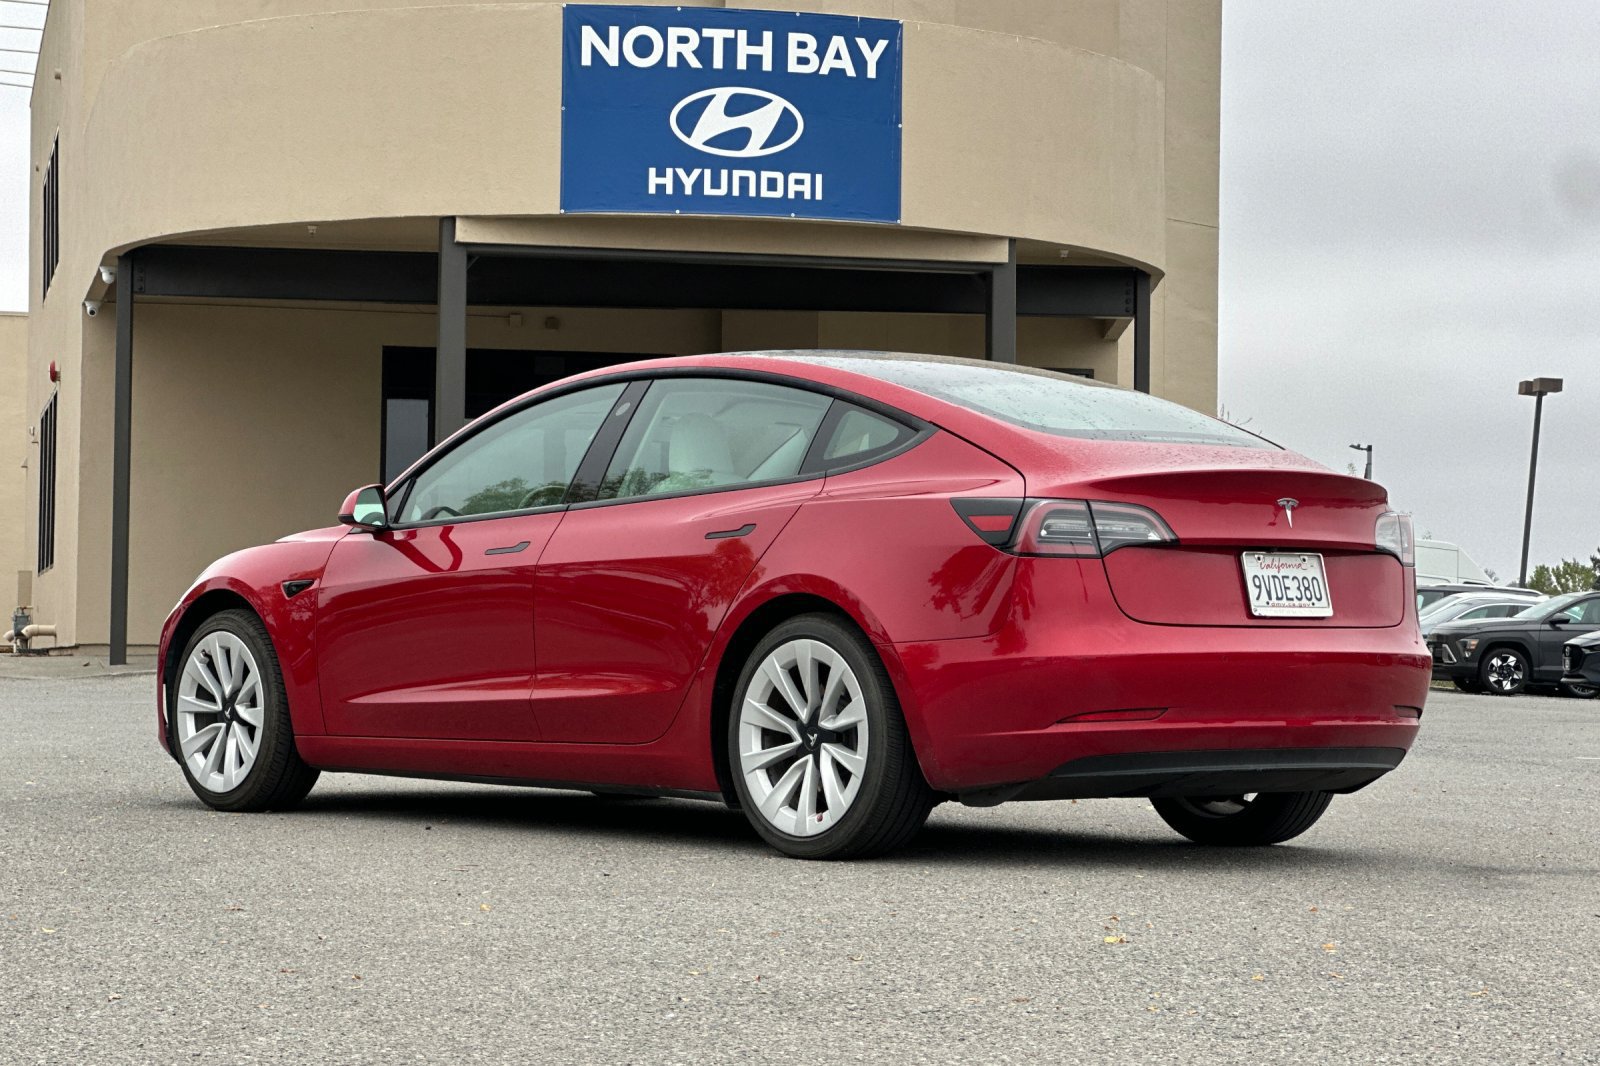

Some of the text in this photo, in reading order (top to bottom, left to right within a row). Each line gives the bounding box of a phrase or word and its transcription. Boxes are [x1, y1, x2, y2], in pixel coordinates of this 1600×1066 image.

[581, 25, 889, 79] NORTH BAY
[648, 167, 823, 201] HYUNDAI
[1259, 557, 1308, 573] California
[1252, 574, 1323, 602] 9VDE380
